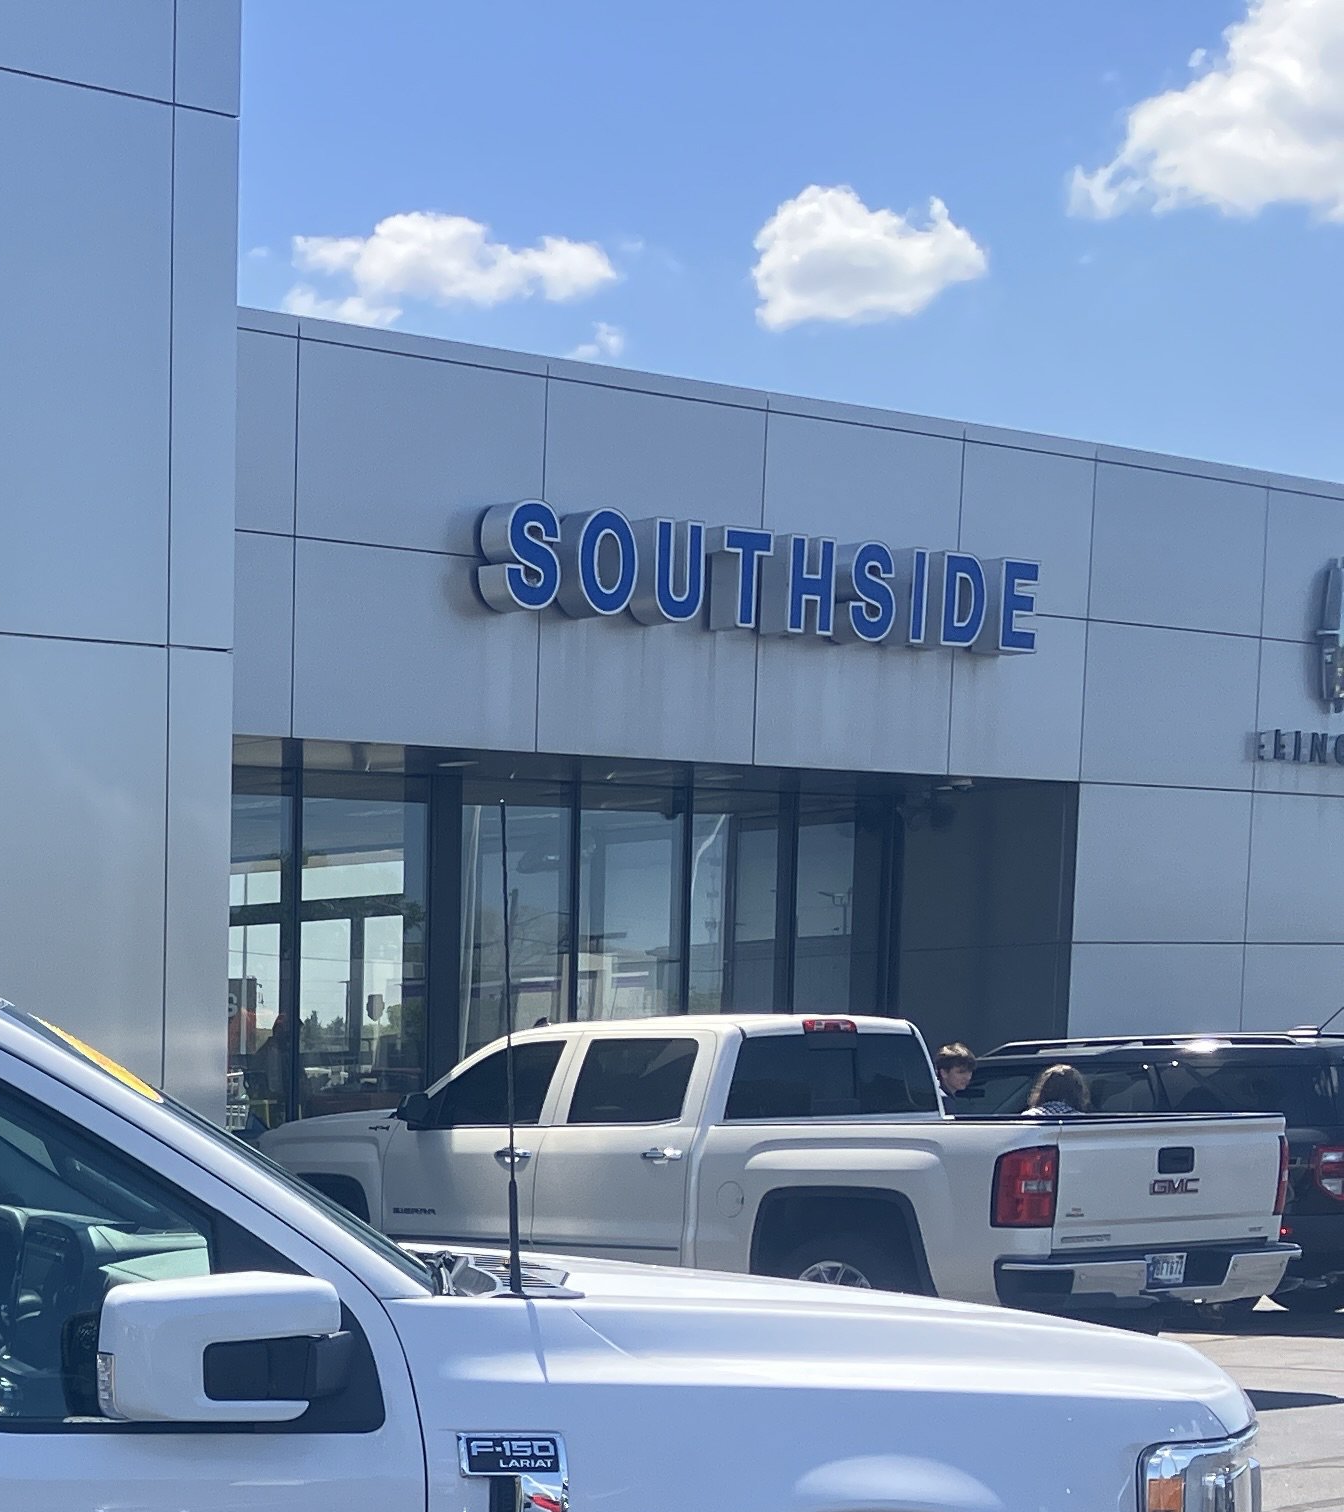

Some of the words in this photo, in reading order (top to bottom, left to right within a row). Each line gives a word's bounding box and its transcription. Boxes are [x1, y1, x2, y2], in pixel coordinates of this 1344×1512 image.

[480, 498, 1042, 656] SOUTHSIDE
[1149, 1177, 1200, 1196] GMC
[470, 1440, 555, 1456] F-150
[499, 1459, 554, 1468] LARIAT
